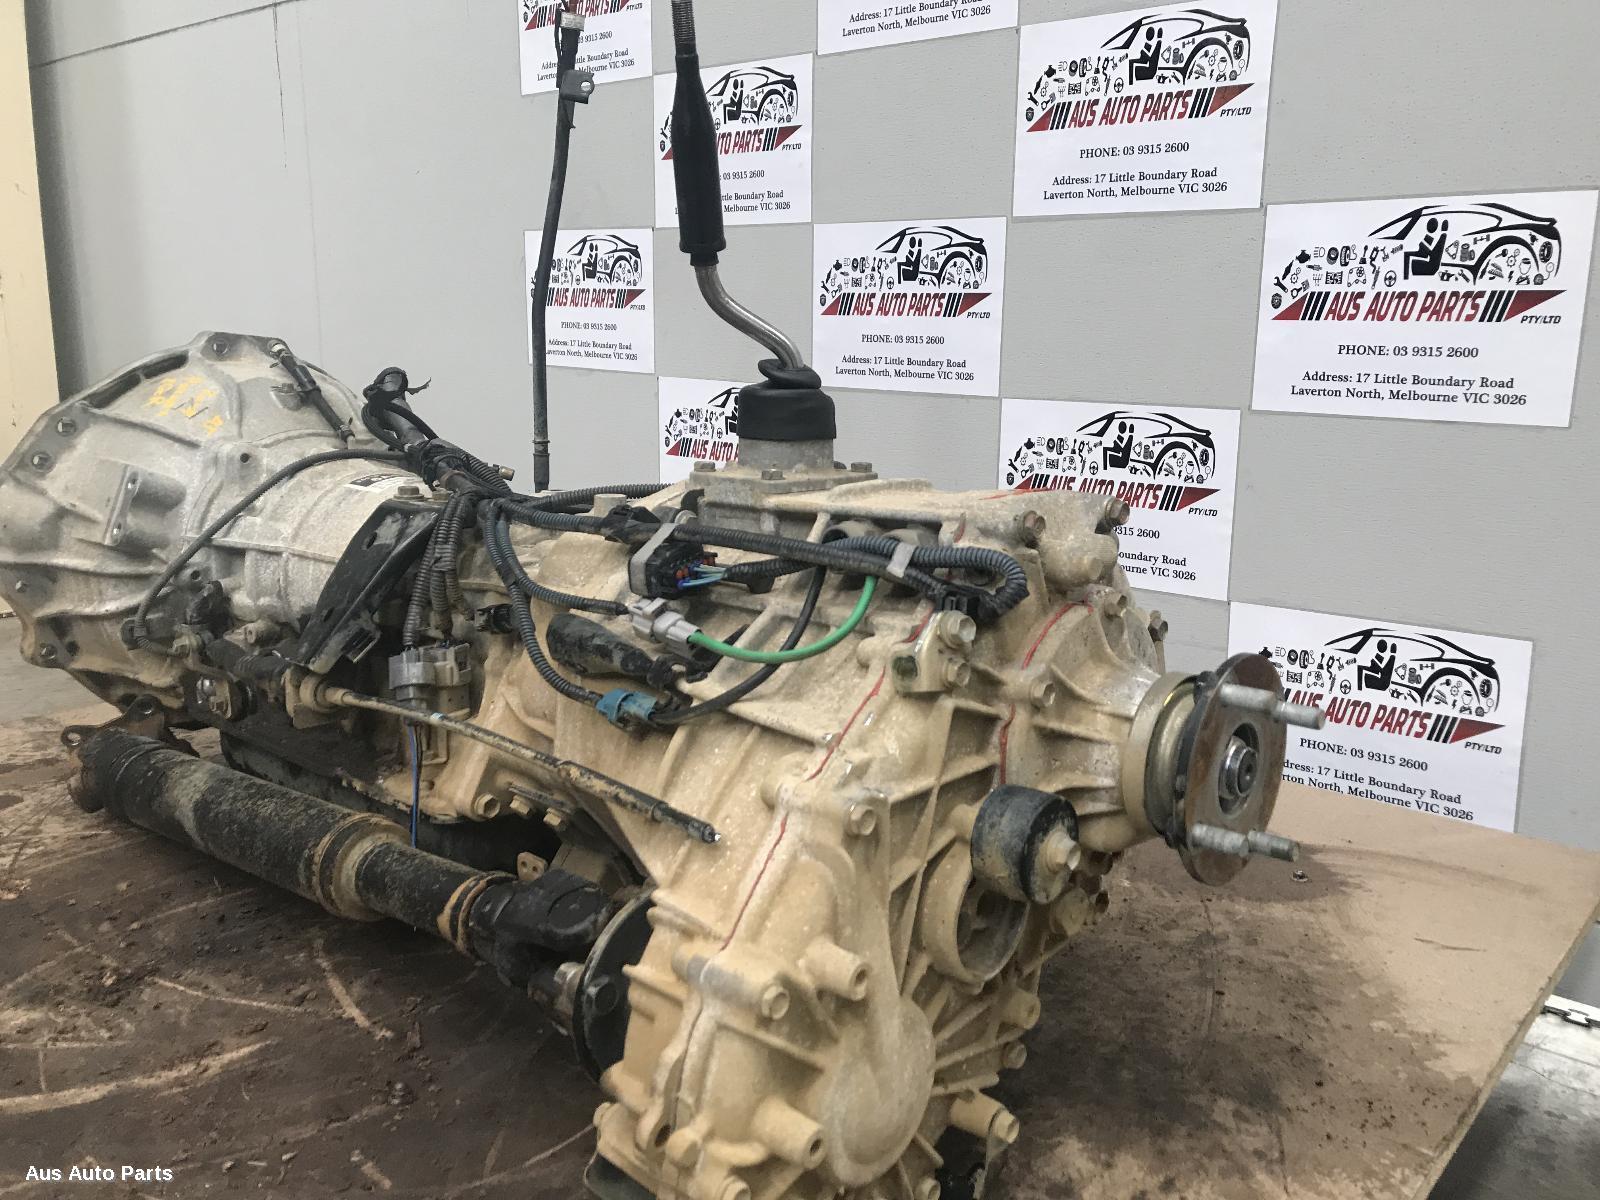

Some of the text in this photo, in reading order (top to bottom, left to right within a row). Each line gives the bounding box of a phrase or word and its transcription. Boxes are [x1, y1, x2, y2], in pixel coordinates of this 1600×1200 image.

[842, 5, 991, 37] Laverton North, Melbourne VIC 3026
[849, 12, 882, 23] Address:
[884, 8, 893, 18] 17
[895, 4, 916, 16] Little
[918, 0, 959, 13] Boundary
[585, 33, 598, 43] 9315
[542, 62, 557, 70] Addre
[587, 52, 613, 63] Boundary
[615, 48, 629, 57] Road
[537, 72, 557, 81] Laverto
[609, 61, 620, 70] VIC
[621, 58, 635, 67] 3026
[1068, 89, 1193, 128] AUS AUTO PARTS
[732, 128, 764, 154] PARTS
[1079, 142, 1190, 158] PHONE: 03 9315 2600
[733, 171, 748, 179] 9315
[749, 169, 765, 178] 2600
[1052, 167, 1218, 186] Address: 17 Little Boundary Road
[734, 190, 765, 202] Boundary
[767, 190, 784, 198] Road
[1043, 182, 1228, 200] Laverton North, Melbourne VIC 3026
[723, 201, 791, 213] Melbourne VIC 3026
[553, 287, 617, 309] AUS AUTO PARTS
[852, 293, 946, 316] AUS AUTO PARTS
[1324, 290, 1486, 322] AUS AUTO PARTS
[561, 321, 581, 329] PHONE:
[583, 322, 590, 330] 03
[570, 339, 577, 347] 17
[577, 339, 591, 348] Little
[592, 340, 617, 351] Boundary
[618, 342, 632, 350] Road
[862, 334, 945, 345] PHONE: 03 9315 2600
[583, 351, 612, 359] Melbourne
[613, 352, 624, 360] VIC
[1337, 345, 1479, 358] PHONE: 03 9315 2600
[842, 355, 966, 370] Address: 17 Little Boundary Road
[835, 366, 974, 381] Laverton North, Melbourne VIC 3026
[1302, 371, 1514, 390] Address: 17 Little Boundary Road
[1291, 386, 1527, 405] Laverton North, Melbourne VIC 3026
[691, 439, 709, 459] AUS
[709, 441, 733, 461] AUTO
[1115, 481, 1163, 509] PARTS
[1136, 528, 1160, 539] 2600
[1118, 552, 1186, 567] oundary Road
[1150, 567, 1170, 577] VIC
[1172, 570, 1196, 581] 3026
[1325, 696, 1371, 728] AUTO
[1370, 704, 1432, 739] PARTS
[1300, 738, 1428, 771] PHONE: 03 9315 2600
[1284, 759, 1462, 804] dress: 17 Little Boundary Road
[1308, 777, 1344, 794] North,
[1347, 785, 1411, 808] Melbourne
[1415, 800, 1440, 815] VIC
[1443, 807, 1474, 821] 3026
